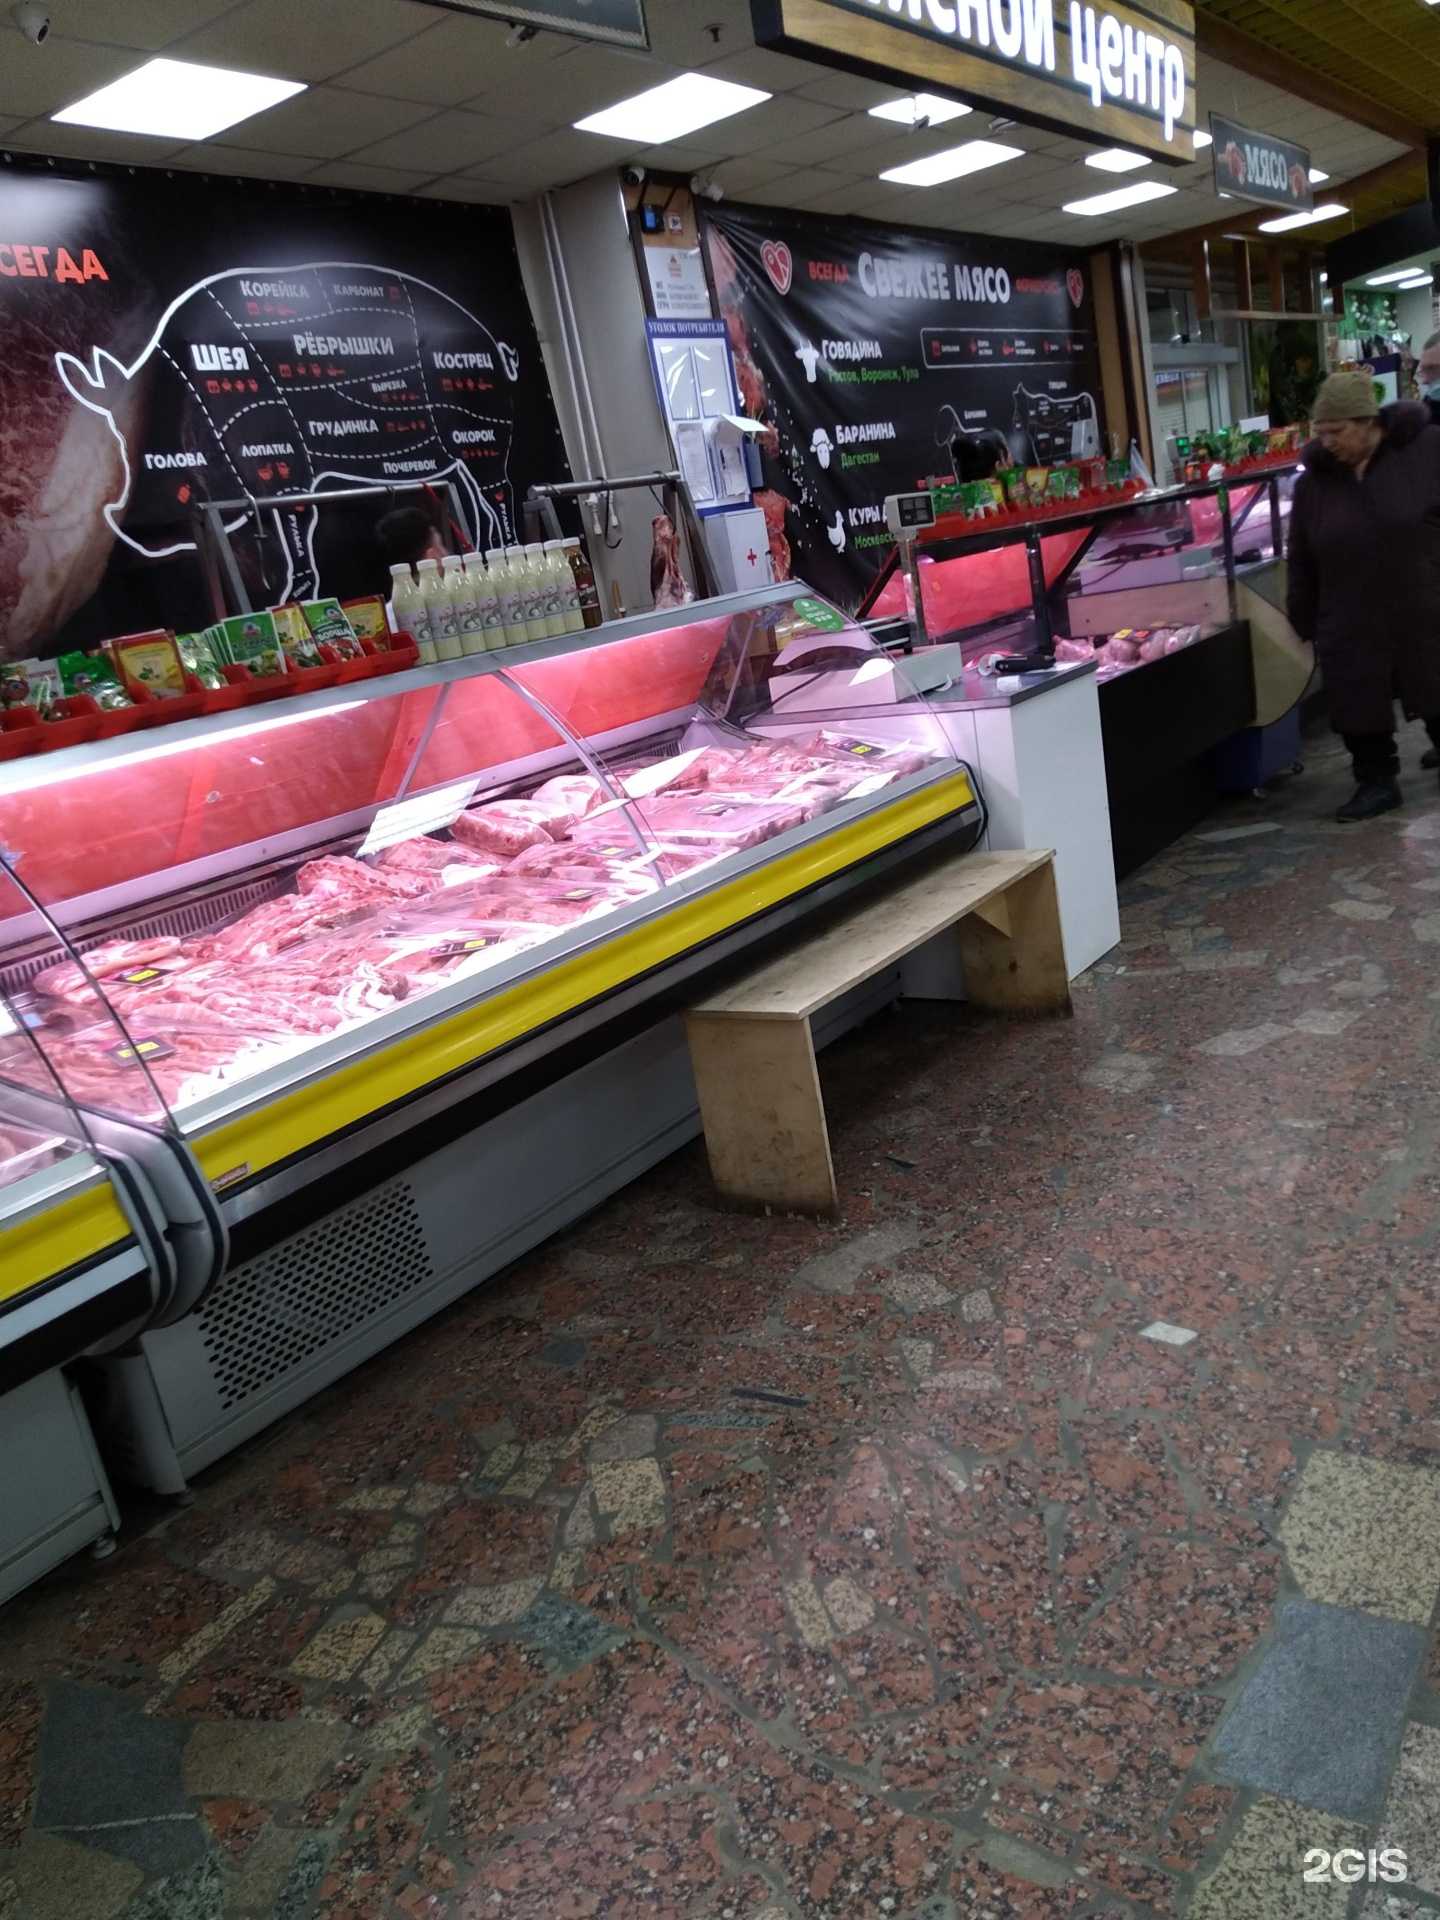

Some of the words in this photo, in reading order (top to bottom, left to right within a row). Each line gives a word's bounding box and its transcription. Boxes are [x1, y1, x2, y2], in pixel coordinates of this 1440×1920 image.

[1069, 1, 1185, 142] центр
[1244, 144, 1288, 191] МЯСО
[858, 252, 950, 300] СВЕЖЕЕ
[954, 264, 1010, 304] МЯСО
[293, 332, 394, 356] РЁБРЫШКИ
[822, 340, 882, 361] ГОВЯДИНА
[190, 344, 250, 371] ШЕЯ
[433, 352, 494, 370] КОСТРЕЦ
[309, 419, 379, 437] ГРУДИНКА
[452, 429, 496, 444] ОКОРОК
[835, 421, 896, 445] БАРАНИНА
[145, 452, 208, 469] ГОЛОВА
[241, 443, 295, 457] ЛОПАТКА
[383, 459, 437, 474] ПОЧЕРЕВОК
[848, 505, 880, 527] КУРЫ
